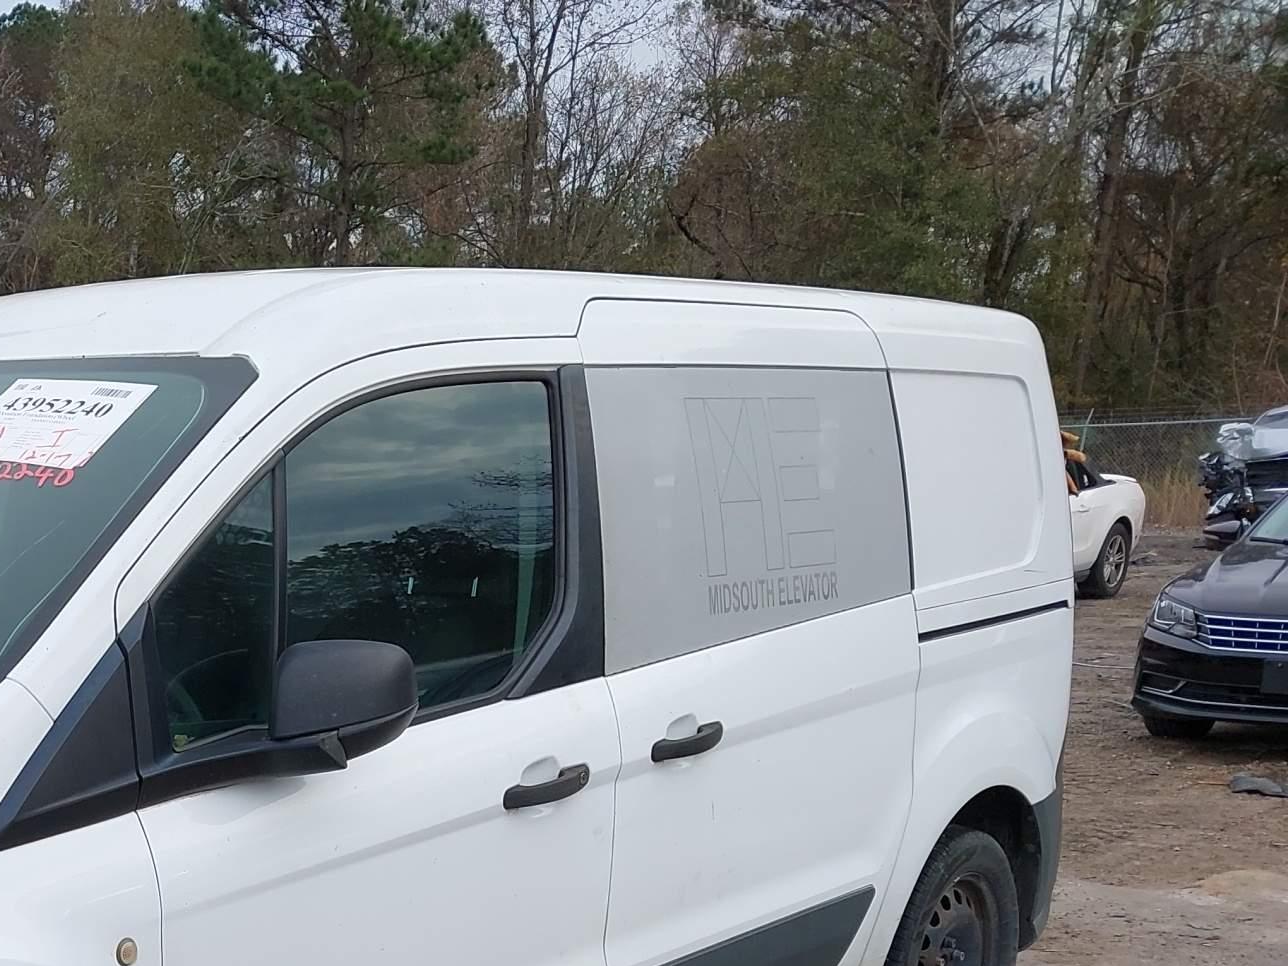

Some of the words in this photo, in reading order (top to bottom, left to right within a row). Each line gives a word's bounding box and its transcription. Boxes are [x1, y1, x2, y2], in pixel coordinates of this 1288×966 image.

[3, 397, 114, 418] 43952240
[708, 580, 775, 616] MIDSOUTH
[778, 573, 839, 606] ELEVATOR
